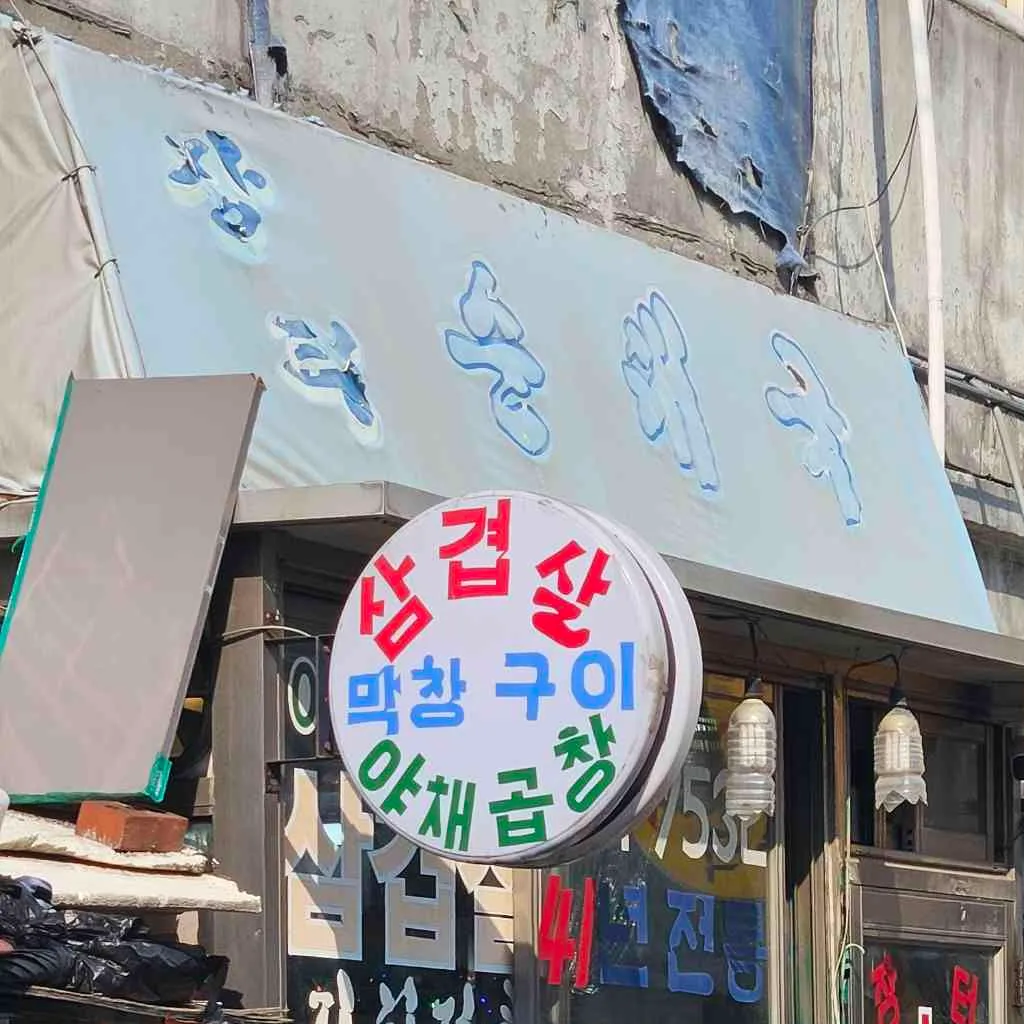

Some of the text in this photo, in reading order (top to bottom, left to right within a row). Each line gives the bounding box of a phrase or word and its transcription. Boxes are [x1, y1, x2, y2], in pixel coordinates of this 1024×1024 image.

[359, 498, 613, 663] 삼겹살
[347, 641, 636, 736] 막창 구이
[358, 713, 617, 852] 야채 곱창
